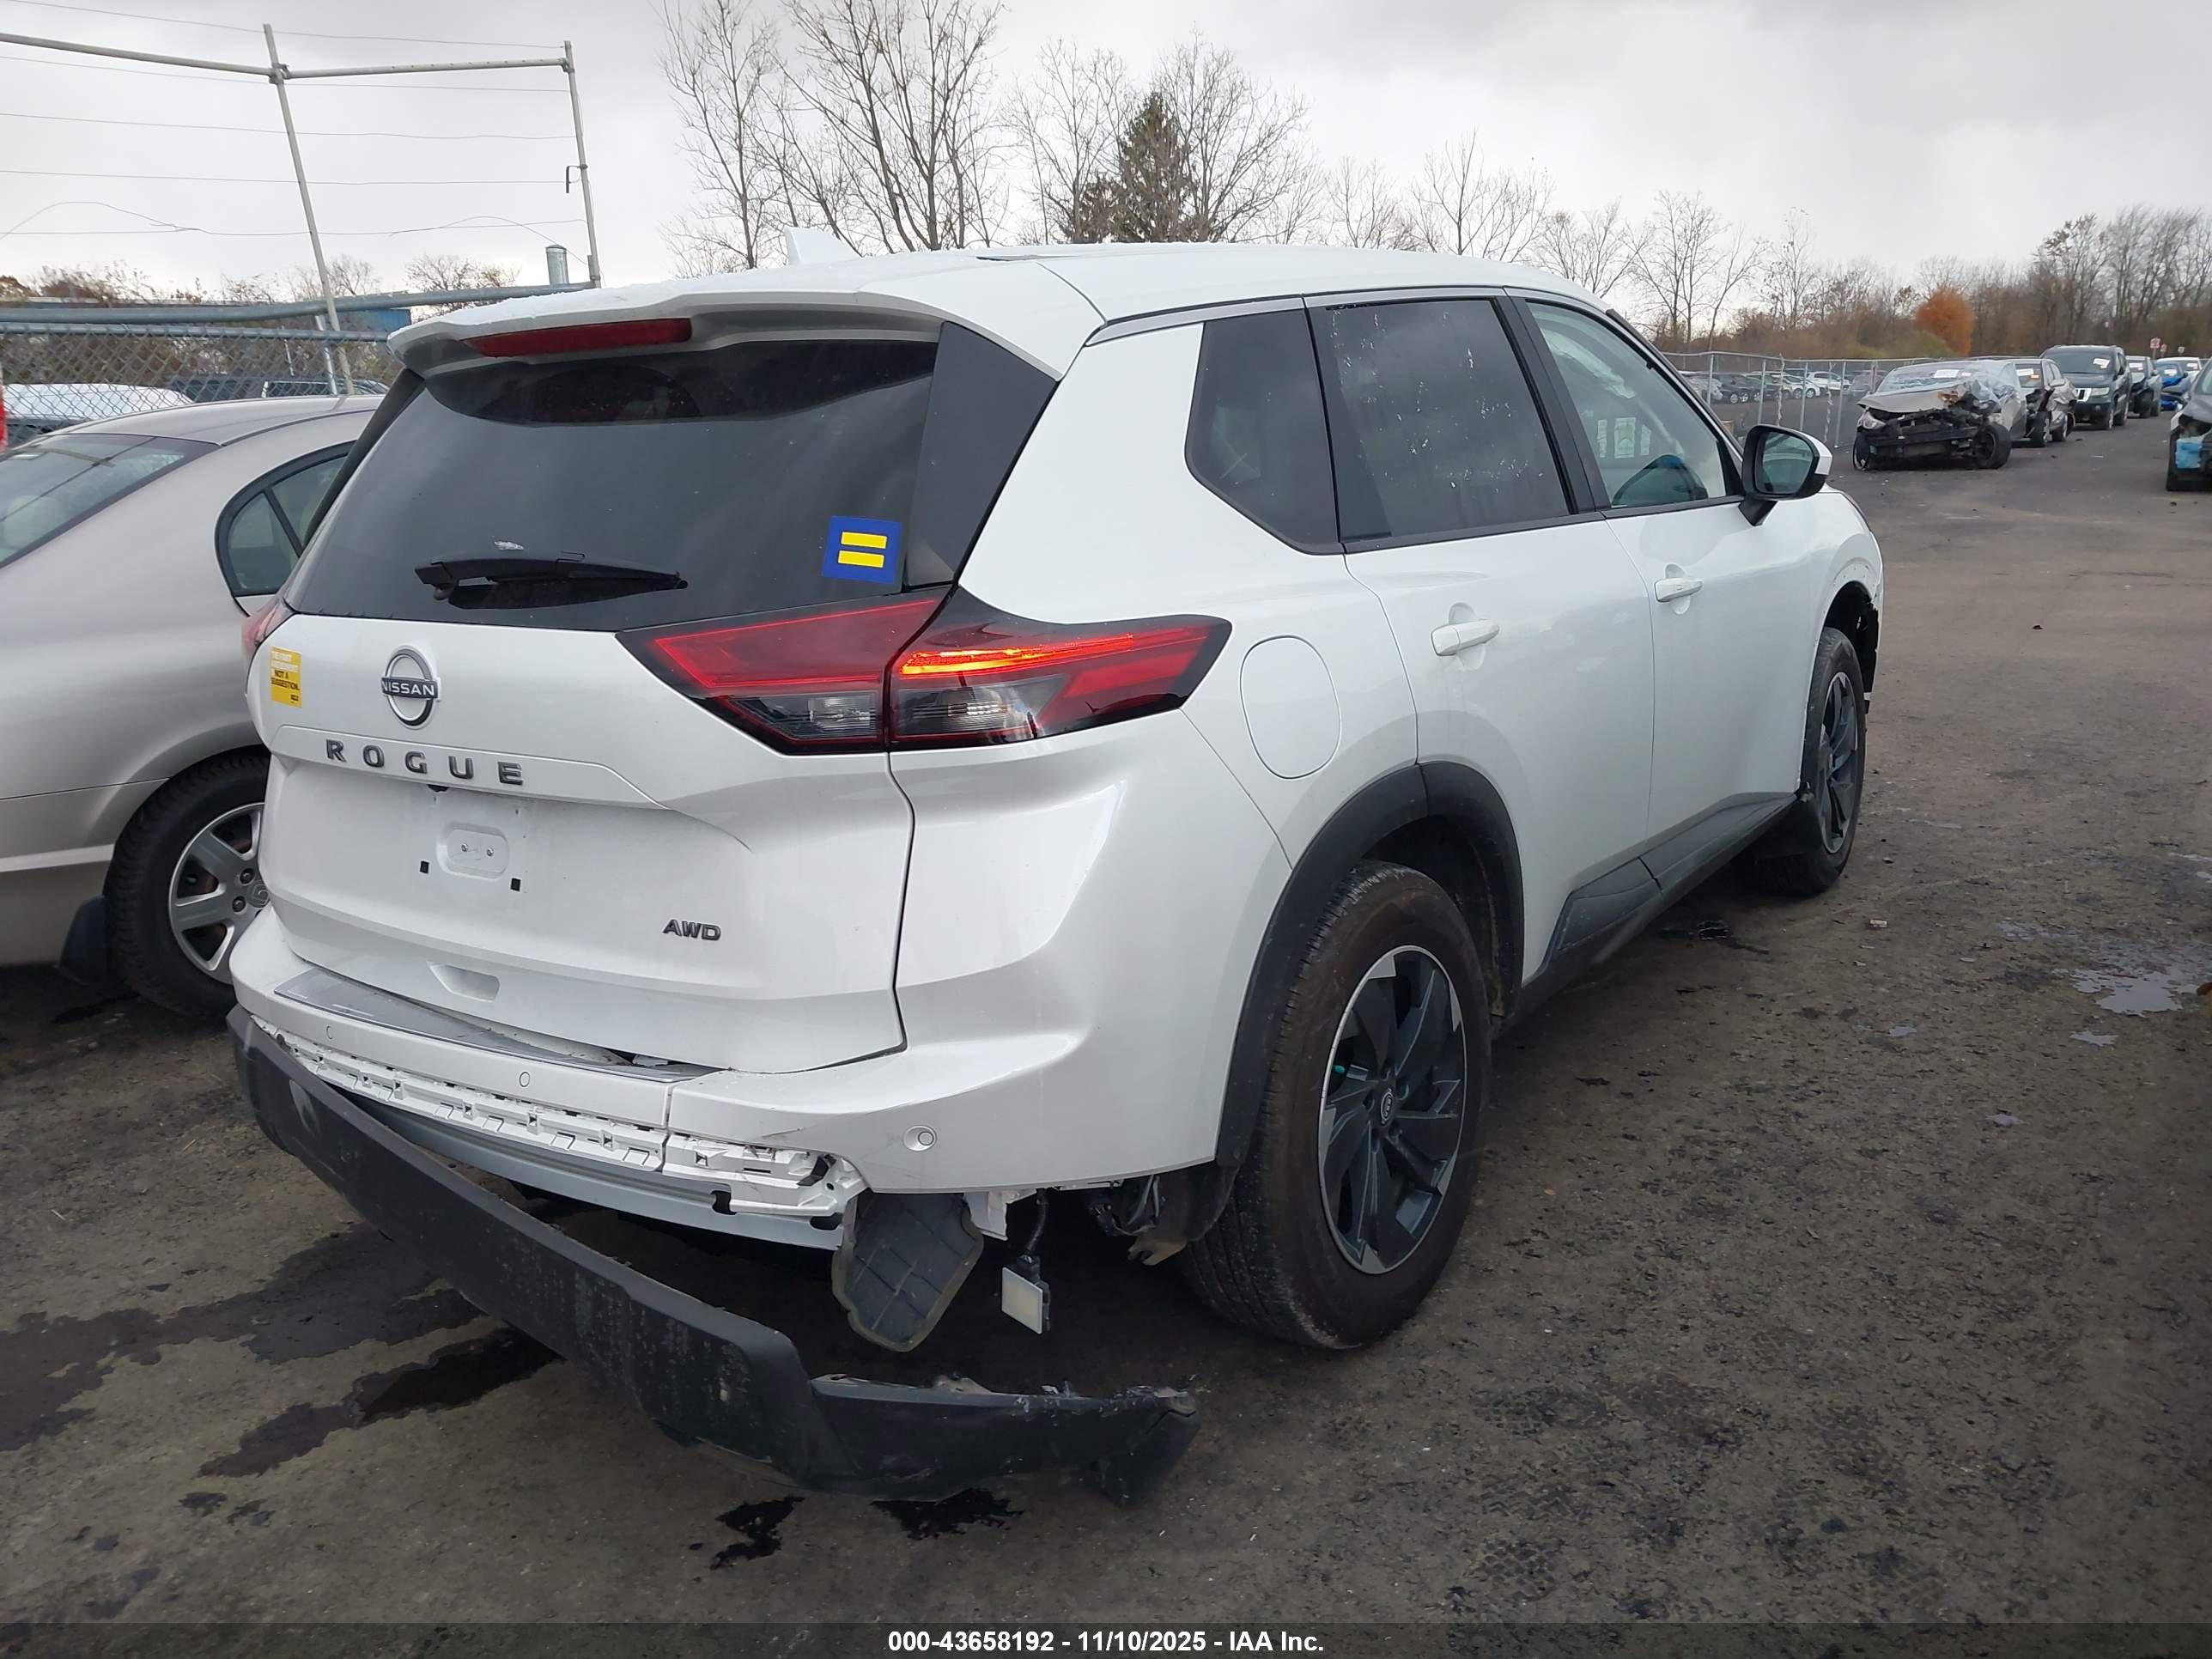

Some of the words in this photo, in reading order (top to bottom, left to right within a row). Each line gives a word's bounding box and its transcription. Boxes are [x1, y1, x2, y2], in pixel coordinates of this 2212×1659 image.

[381, 680, 435, 696] NISSAN
[325, 738, 524, 786] ROGUE
[662, 919, 721, 941] AWD
